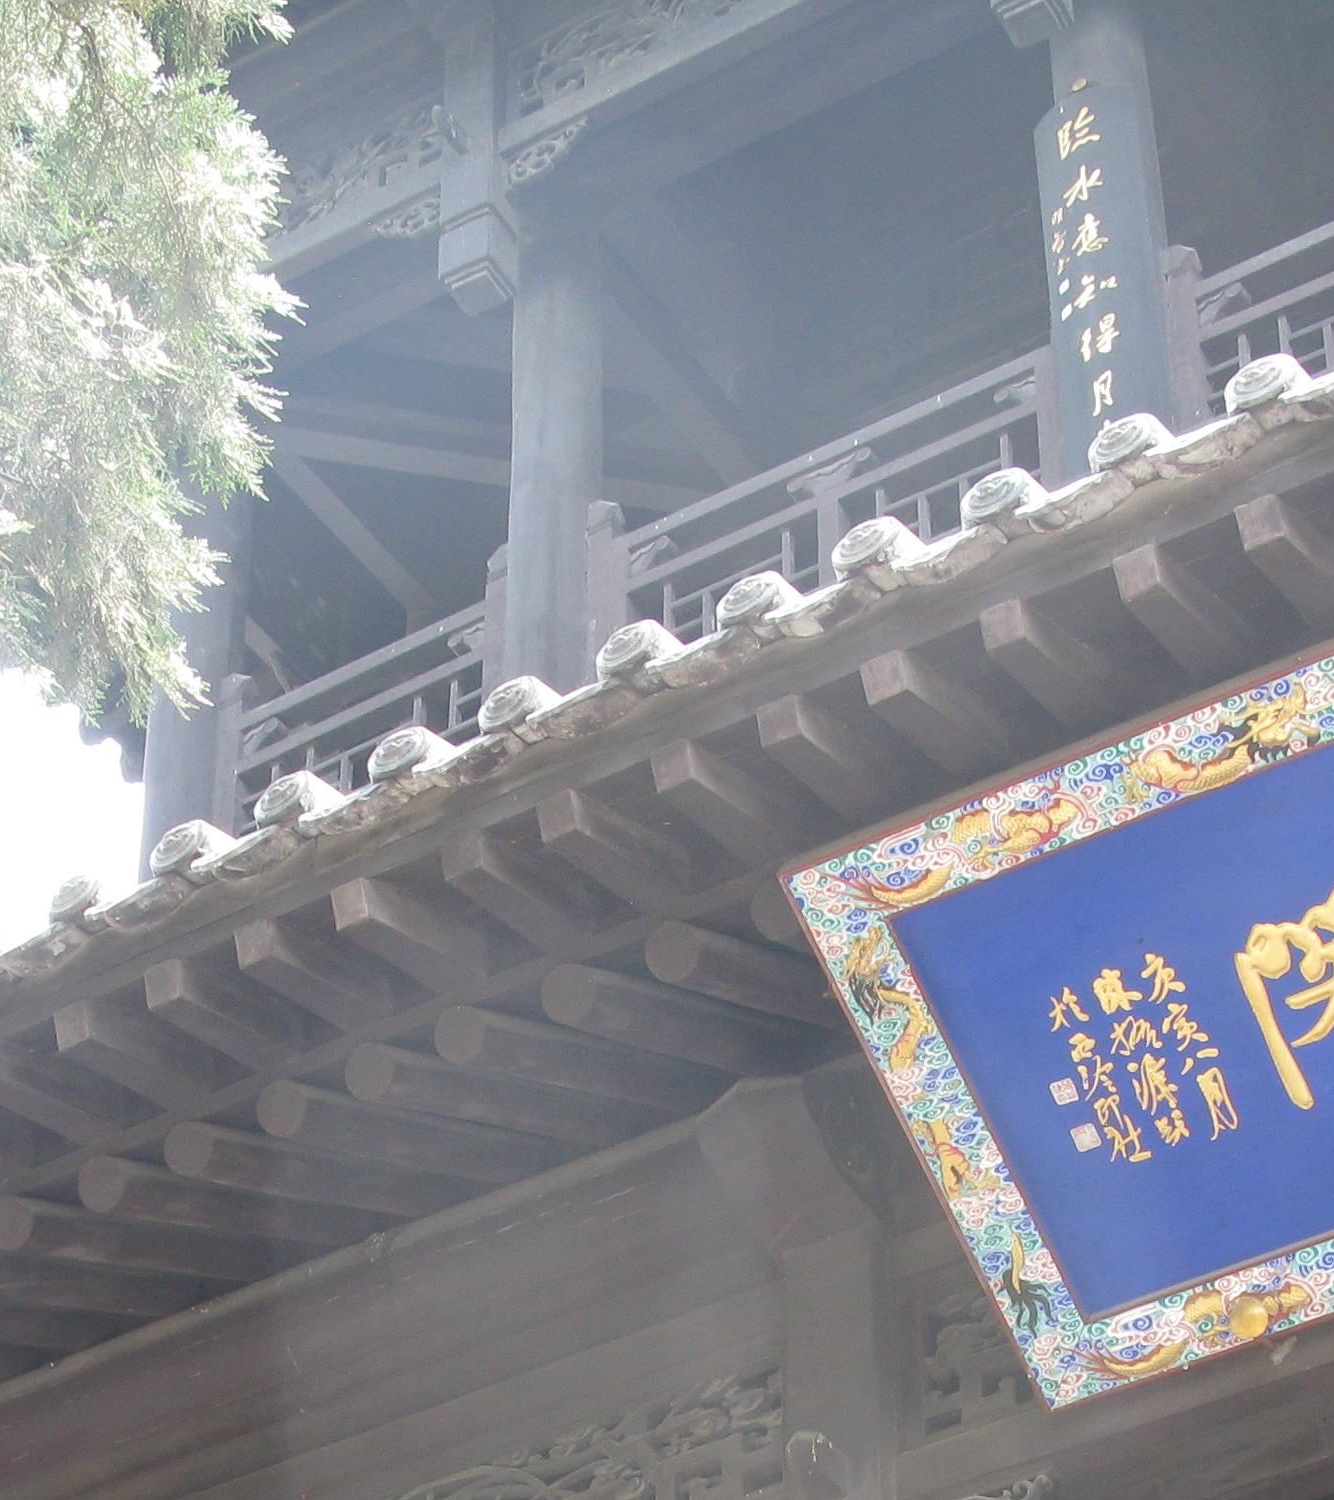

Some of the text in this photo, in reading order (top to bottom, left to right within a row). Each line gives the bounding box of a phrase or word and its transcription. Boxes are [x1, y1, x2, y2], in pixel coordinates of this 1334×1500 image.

[1057, 105, 1120, 428] 臨水應知得月
